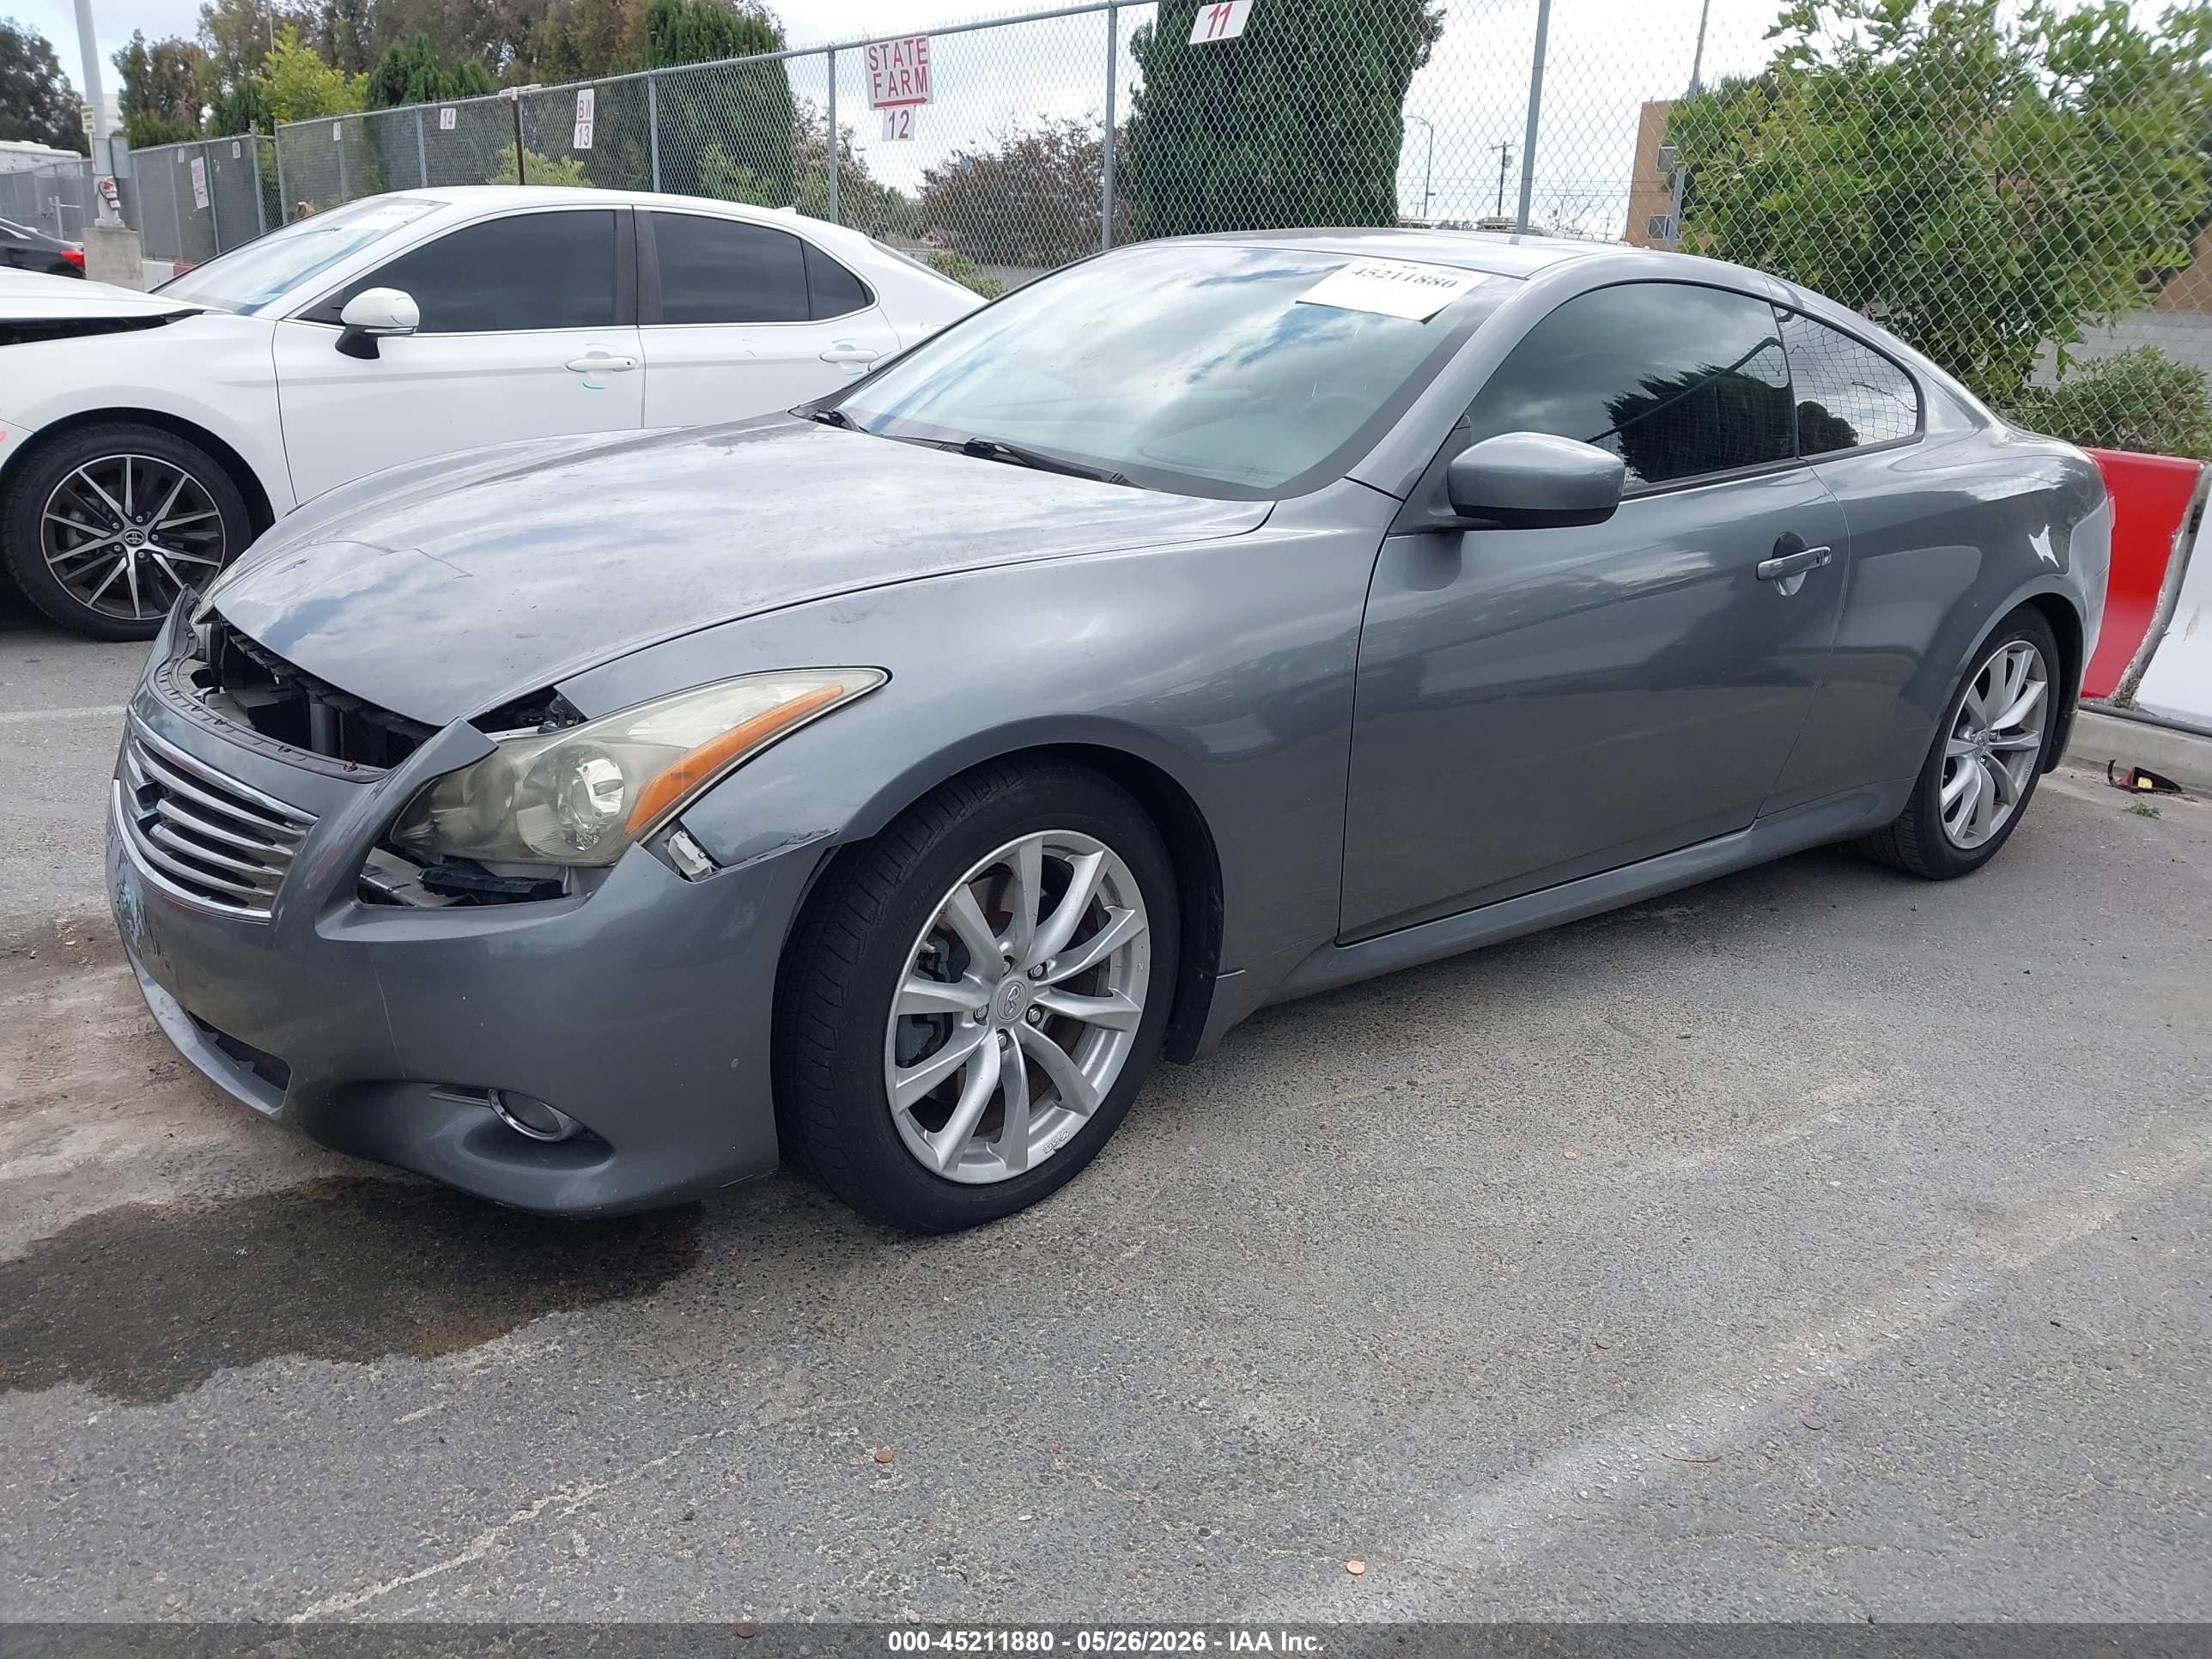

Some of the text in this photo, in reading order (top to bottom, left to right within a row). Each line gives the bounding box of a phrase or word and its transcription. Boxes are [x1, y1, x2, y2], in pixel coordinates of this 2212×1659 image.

[1206, 3, 1233, 39] 11
[868, 37, 928, 71] STATE
[872, 66, 928, 99] FARM
[443, 109, 453, 127] 14
[889, 109, 909, 140] 12
[578, 125, 590, 146] 13
[1352, 267, 1458, 289] 45211880
